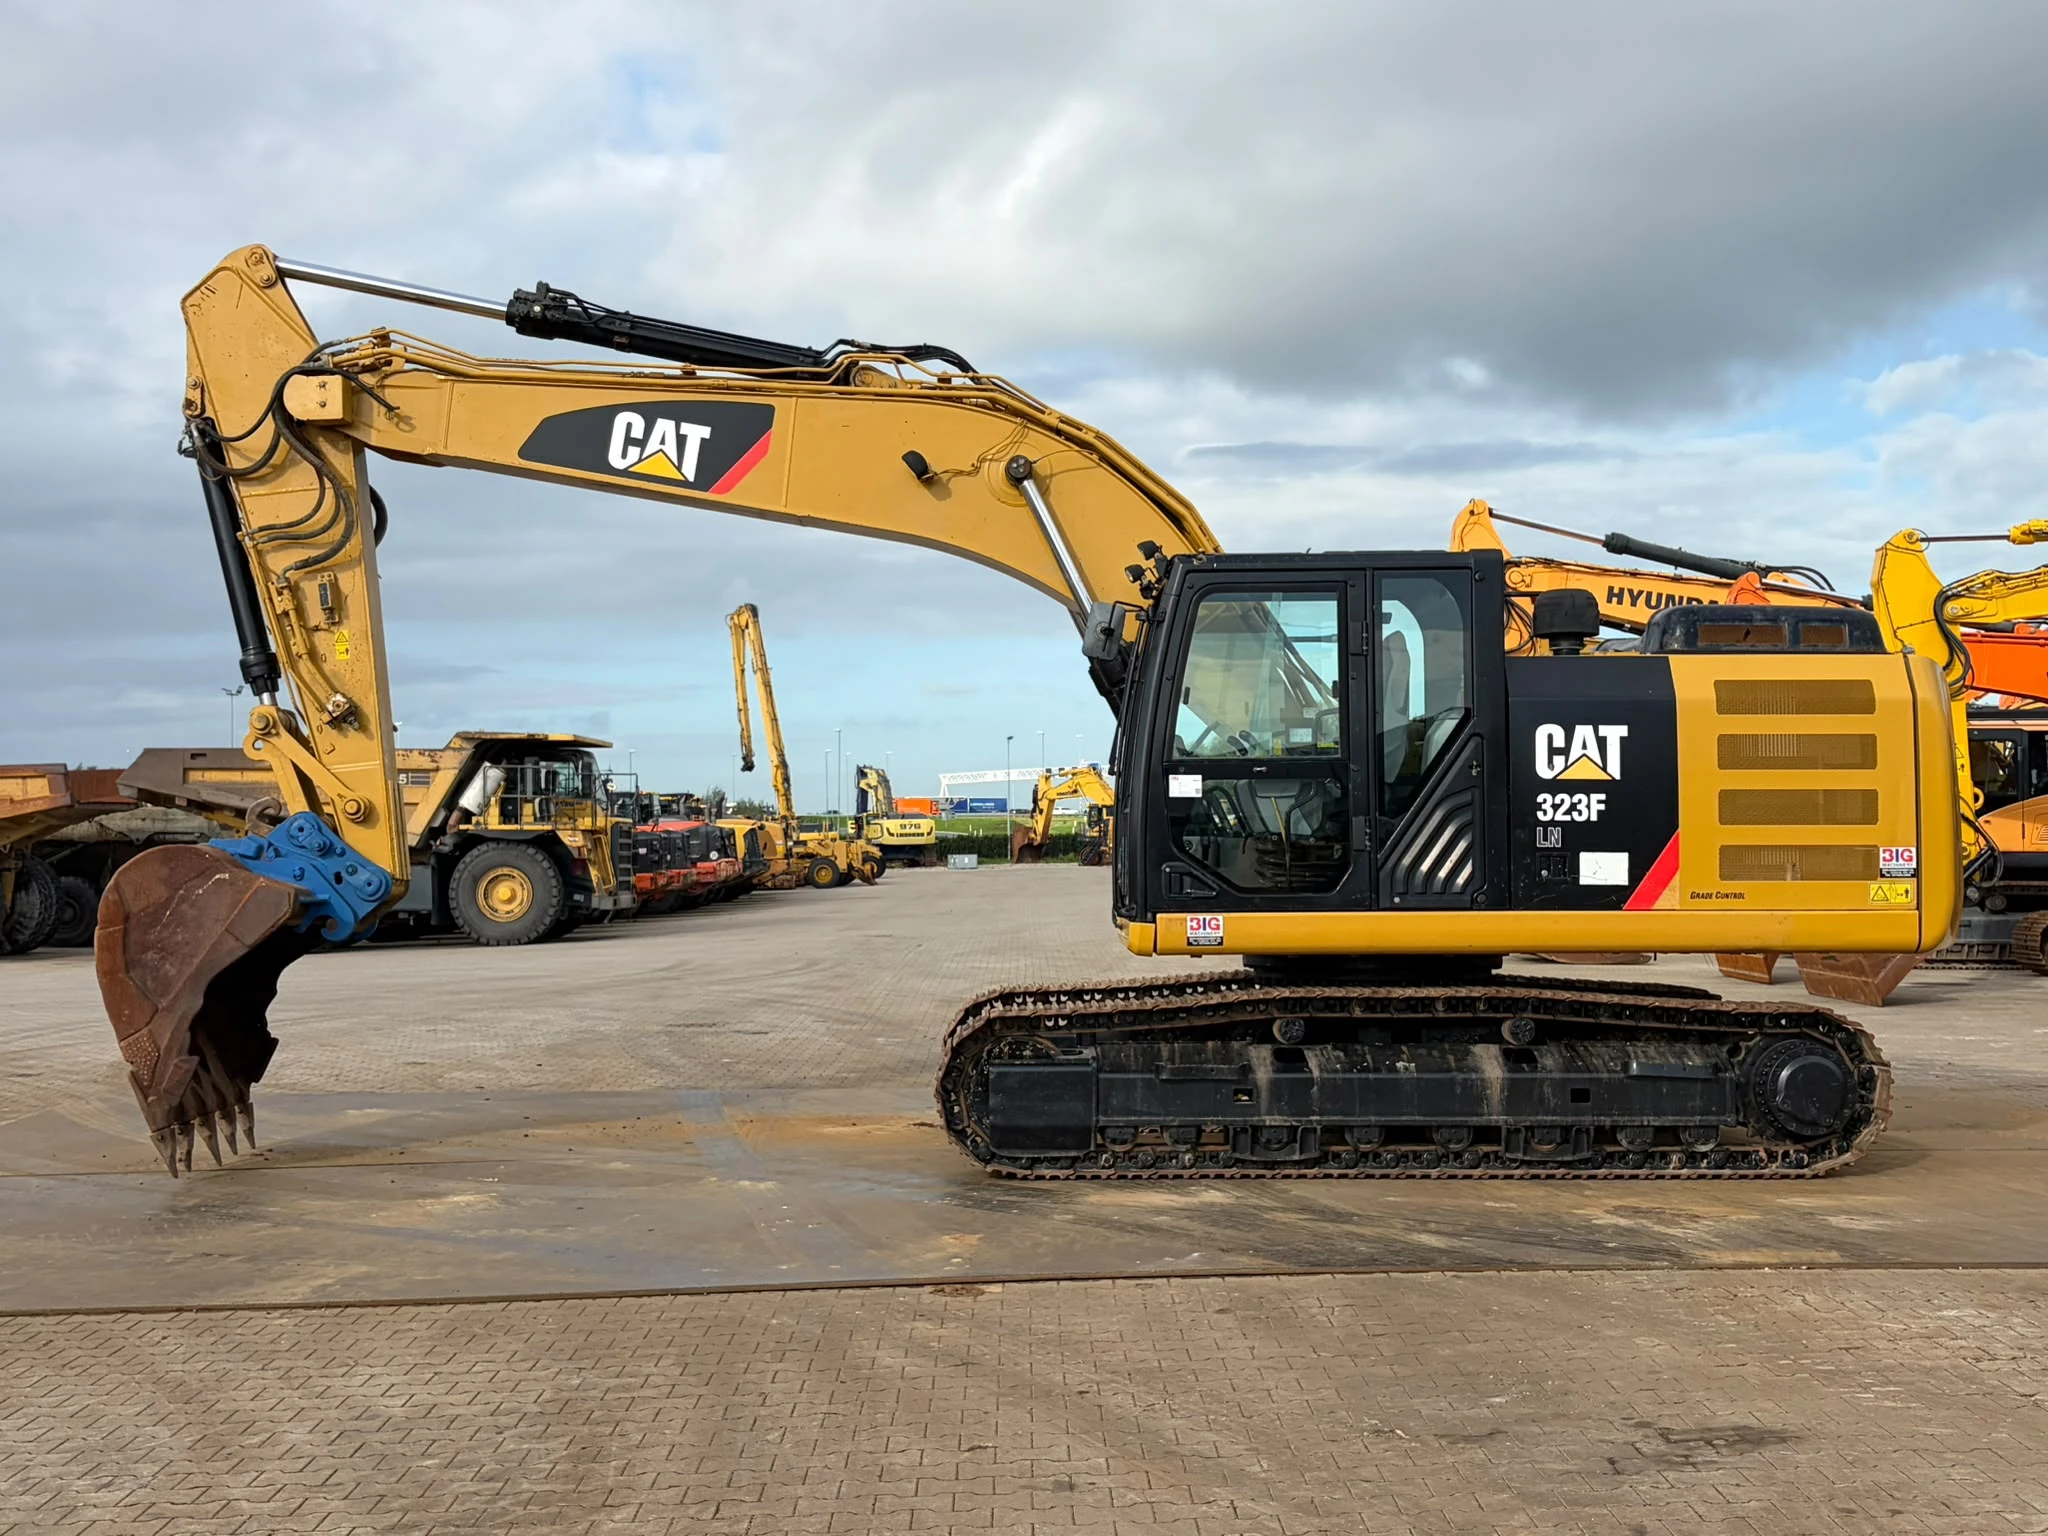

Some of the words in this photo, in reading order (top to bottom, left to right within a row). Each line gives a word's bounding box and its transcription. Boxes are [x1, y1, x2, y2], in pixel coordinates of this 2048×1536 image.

[607, 411, 712, 482] CAT
[1535, 723, 1629, 780] CAT
[1536, 793, 1607, 822] 323F
[1536, 827, 1562, 848] LN
[1690, 891, 1714, 900] GRADE
[1715, 891, 1746, 900] CONTROL
